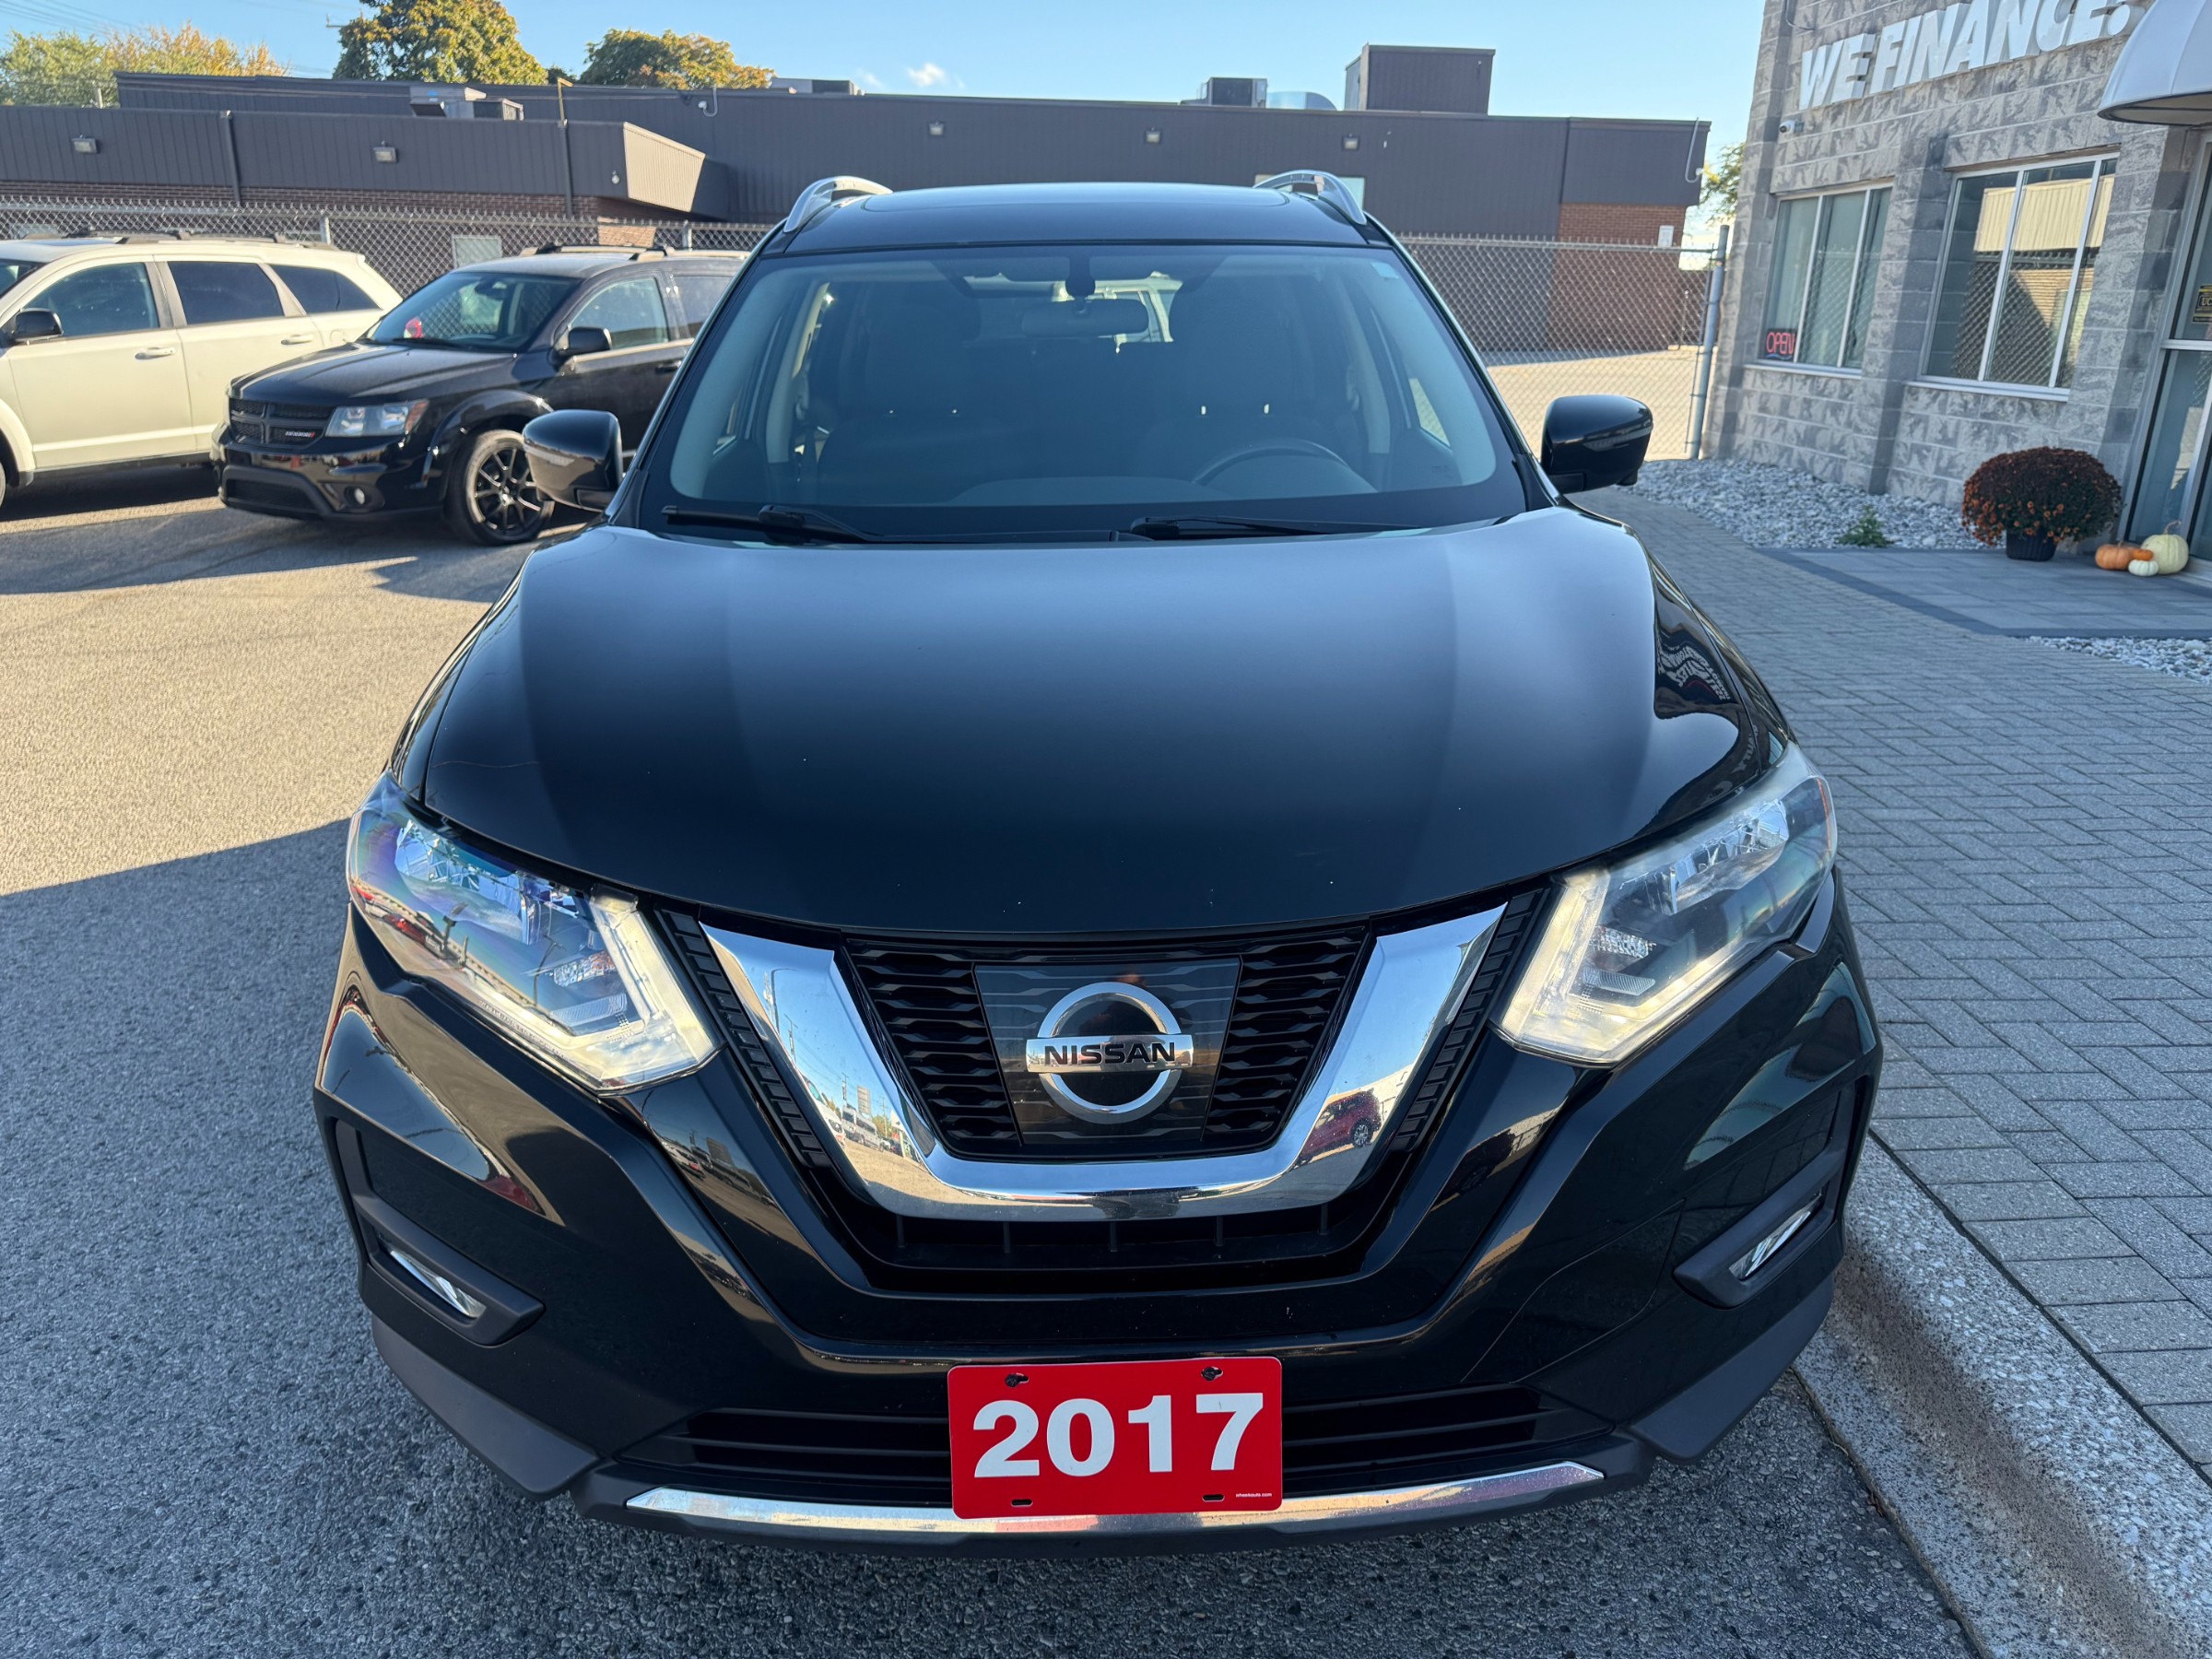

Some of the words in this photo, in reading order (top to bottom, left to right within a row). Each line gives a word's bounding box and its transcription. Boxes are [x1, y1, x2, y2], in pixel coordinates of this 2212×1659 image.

[1798, 34, 1874, 110] WE
[1766, 331, 1796, 355] OPEN
[1043, 1041, 1176, 1065] NISSAN
[972, 1392, 1264, 1478] 2017
